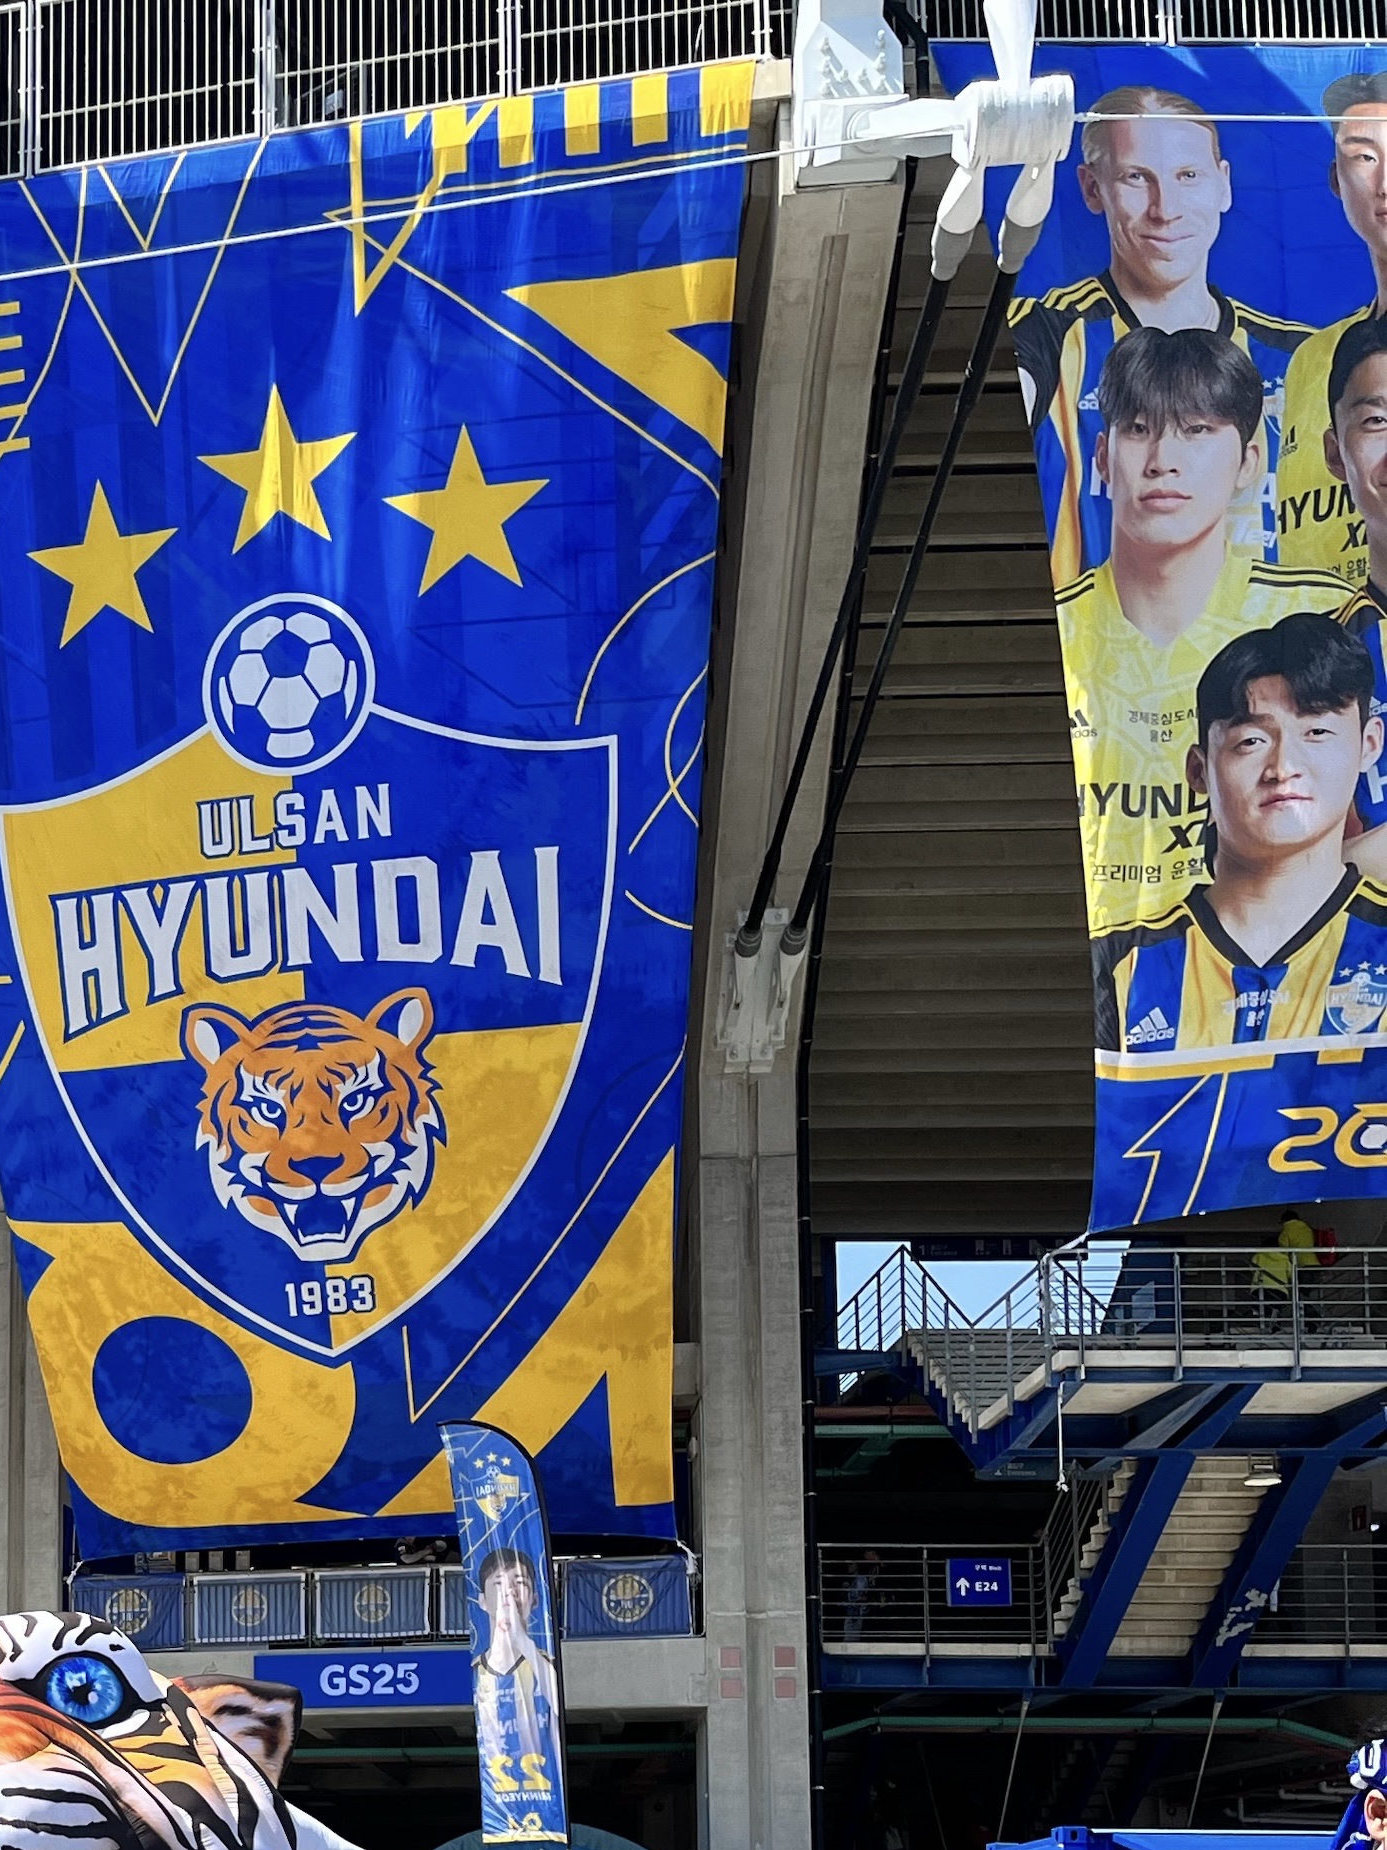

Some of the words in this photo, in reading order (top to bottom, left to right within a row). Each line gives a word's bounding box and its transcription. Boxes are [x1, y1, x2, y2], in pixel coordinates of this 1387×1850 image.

[198, 783, 393, 858] ULSAN
[53, 845, 564, 1038] HYUNDAI
[1124, 1026, 1175, 1045] adidas
[284, 1274, 376, 1318] 1983
[974, 1581, 999, 1592] E24
[320, 1662, 420, 1696] GS25
